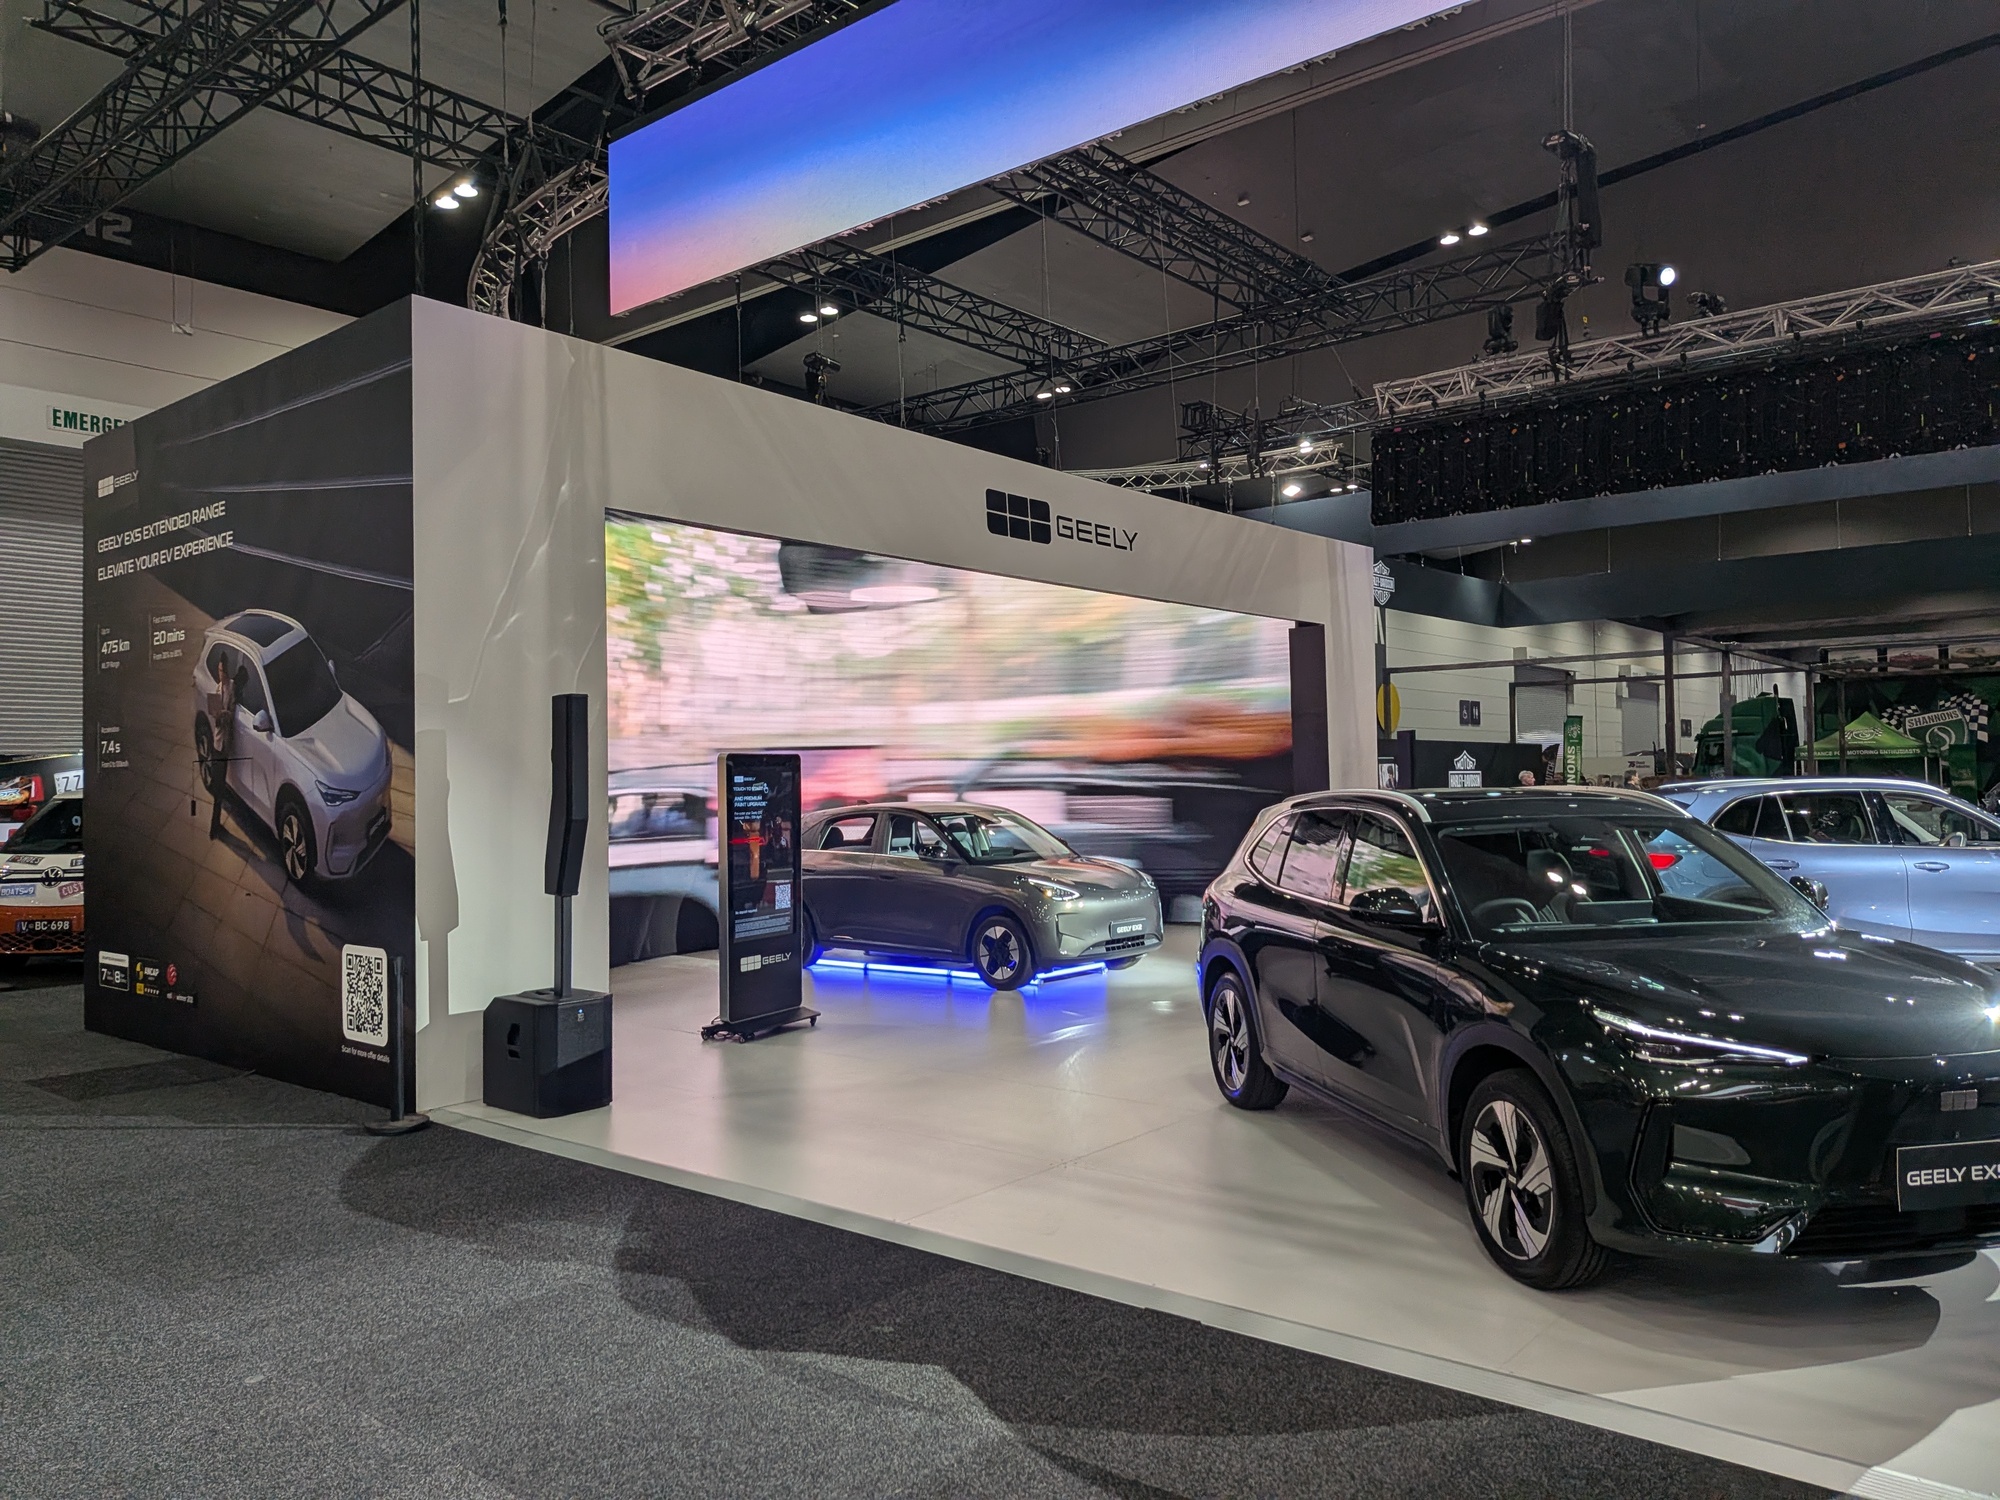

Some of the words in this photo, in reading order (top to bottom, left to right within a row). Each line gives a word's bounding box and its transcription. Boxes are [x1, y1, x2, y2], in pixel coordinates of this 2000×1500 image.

[114, 470, 139, 488] GEELY
[98, 534, 123, 553] GEELY
[124, 528, 142, 545] EX5
[143, 512, 191, 540] EXTENDED
[192, 500, 226, 525] RANGE
[1056, 515, 1138, 551] GEELY
[98, 559, 134, 581] ELEVATE
[135, 552, 159, 571] YOUR
[160, 547, 174, 565] EV
[174, 531, 234, 561] EXPERIENCE
[153, 631, 166, 646] 20
[167, 628, 185, 643] mins
[101, 640, 119, 654] 475
[119, 639, 130, 652] km
[1907, 709, 1960, 728] SHANNONS
[101, 740, 115, 754] 7.4
[1567, 745, 1576, 785] NONS
[762, 952, 792, 965] GEELY
[101, 968, 107, 981] 7
[114, 971, 120, 983] 8
[1907, 1167, 1967, 1186] GEELY
[1971, 1164, 2000, 1181] EX
